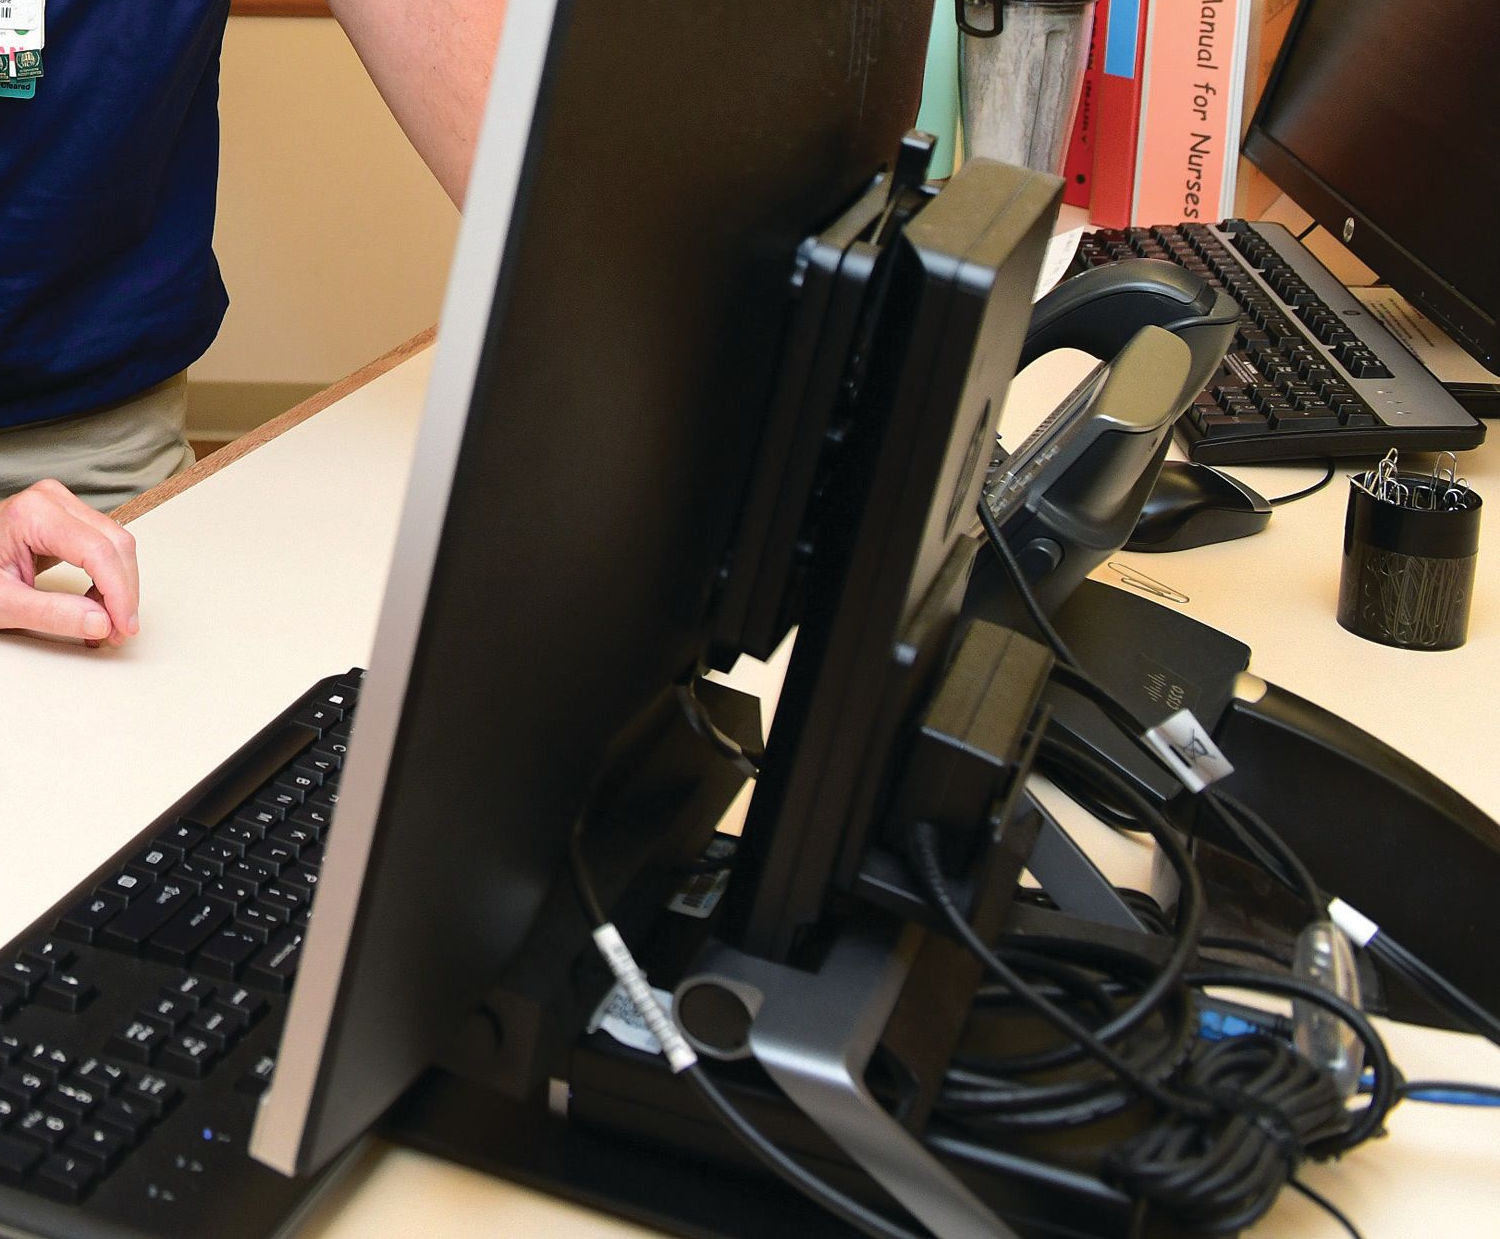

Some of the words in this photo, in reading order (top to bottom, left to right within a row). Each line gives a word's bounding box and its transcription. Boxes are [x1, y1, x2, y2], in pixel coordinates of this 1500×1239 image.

[1, 82, 32, 91] Cleared
[1193, 82, 1217, 121] for
[1183, 132, 1211, 219] Nurses
